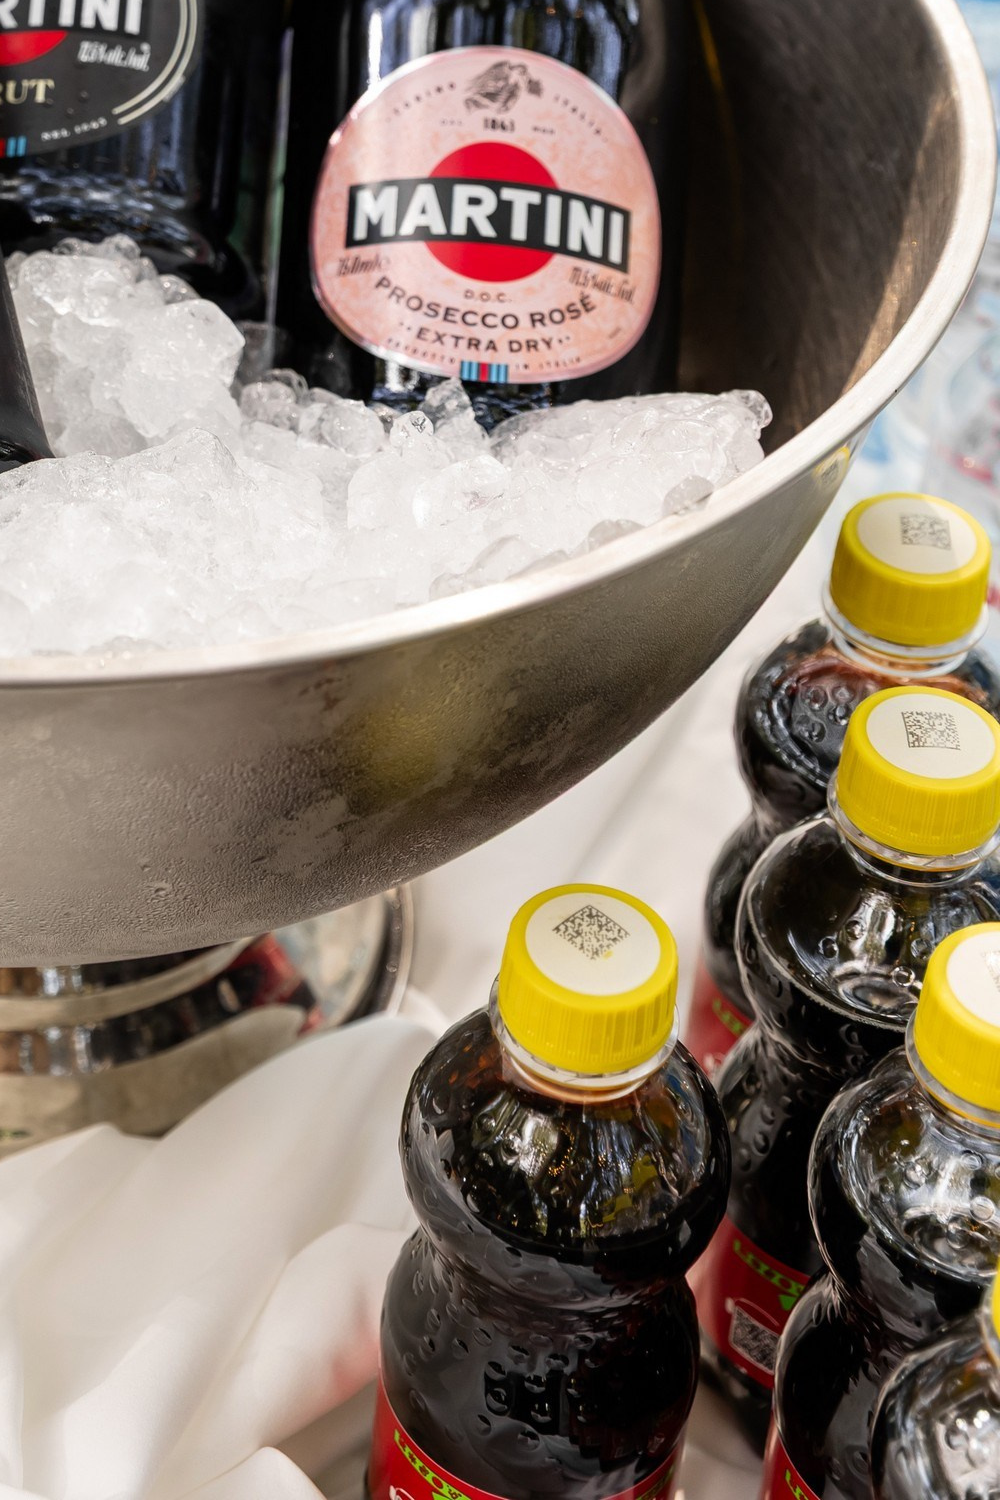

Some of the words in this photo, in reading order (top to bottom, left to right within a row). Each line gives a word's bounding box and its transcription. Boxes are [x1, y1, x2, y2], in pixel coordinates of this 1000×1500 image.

[352, 183, 625, 266] MARTINI
[375, 275, 519, 329] PROSECCO
[416, 326, 498, 353] EXTRA
[508, 336, 554, 353] DRY
